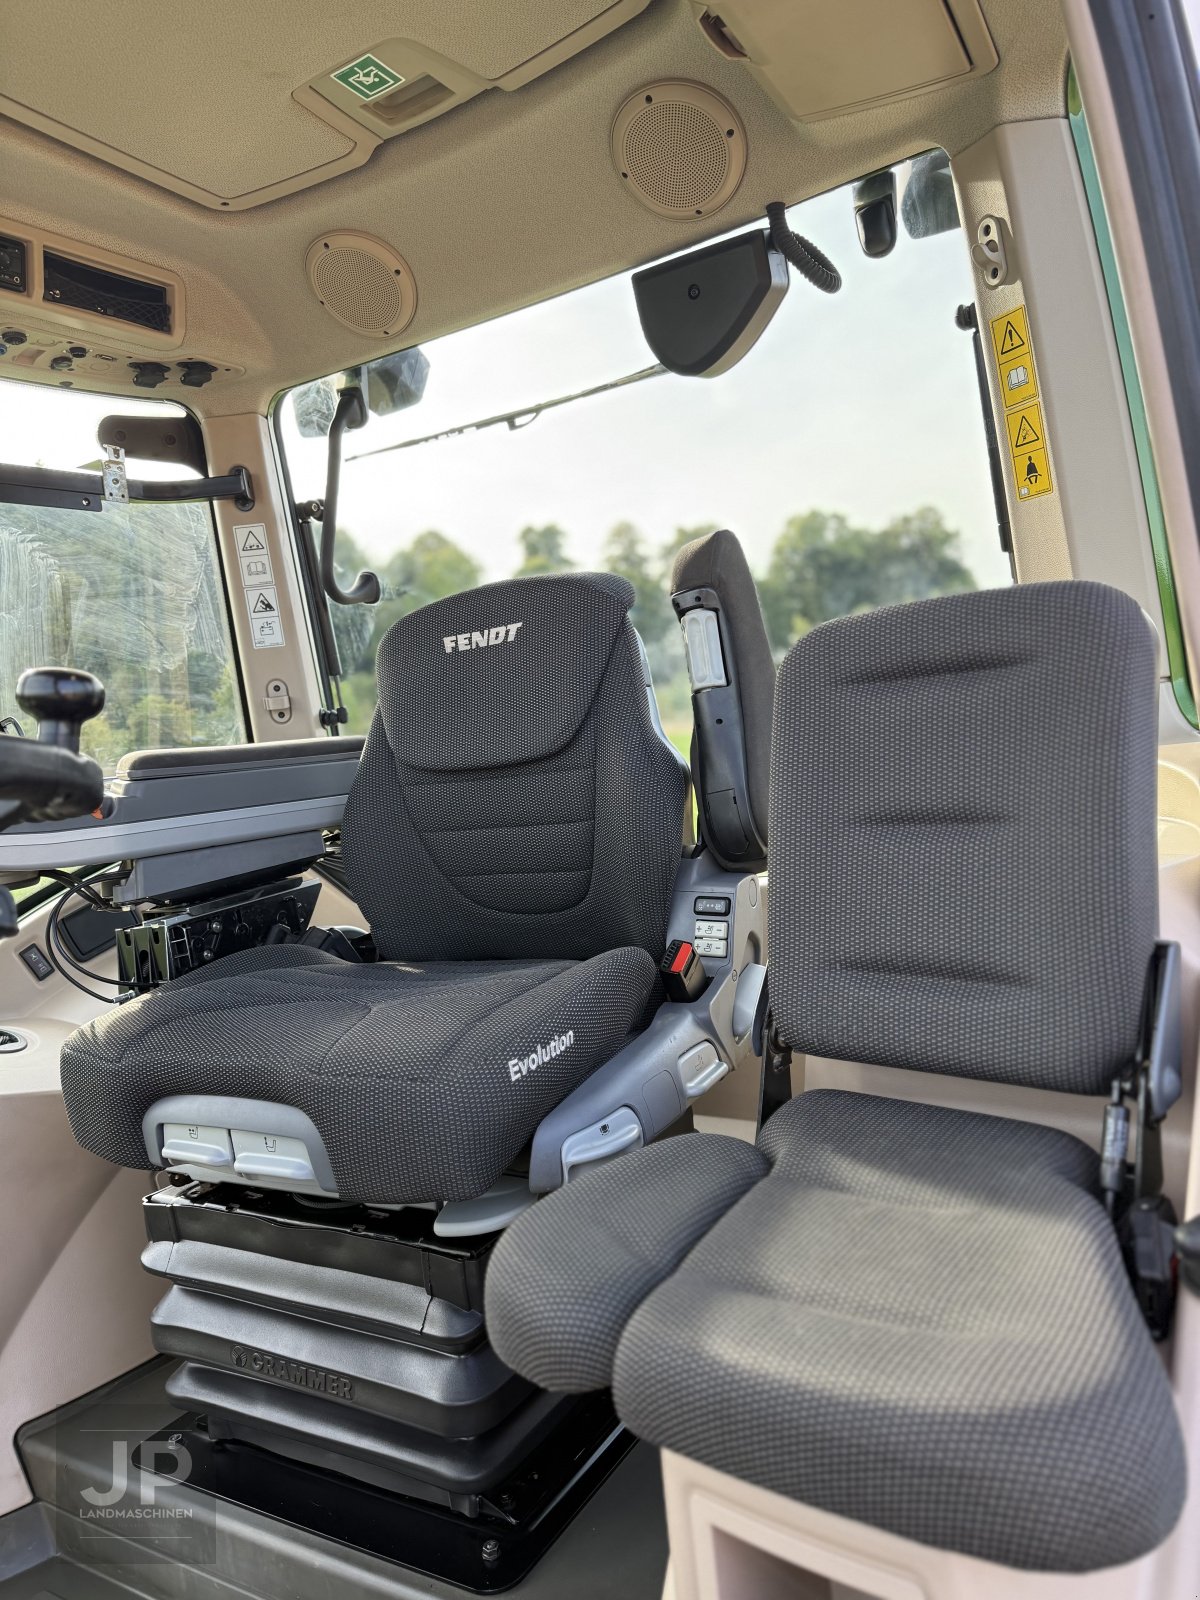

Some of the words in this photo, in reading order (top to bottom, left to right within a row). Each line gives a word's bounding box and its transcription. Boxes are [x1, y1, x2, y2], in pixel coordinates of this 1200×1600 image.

[443, 622, 523, 653] FENDT
[508, 1030, 573, 1081] Evolution
[252, 1352, 354, 1400] GRAMMER
